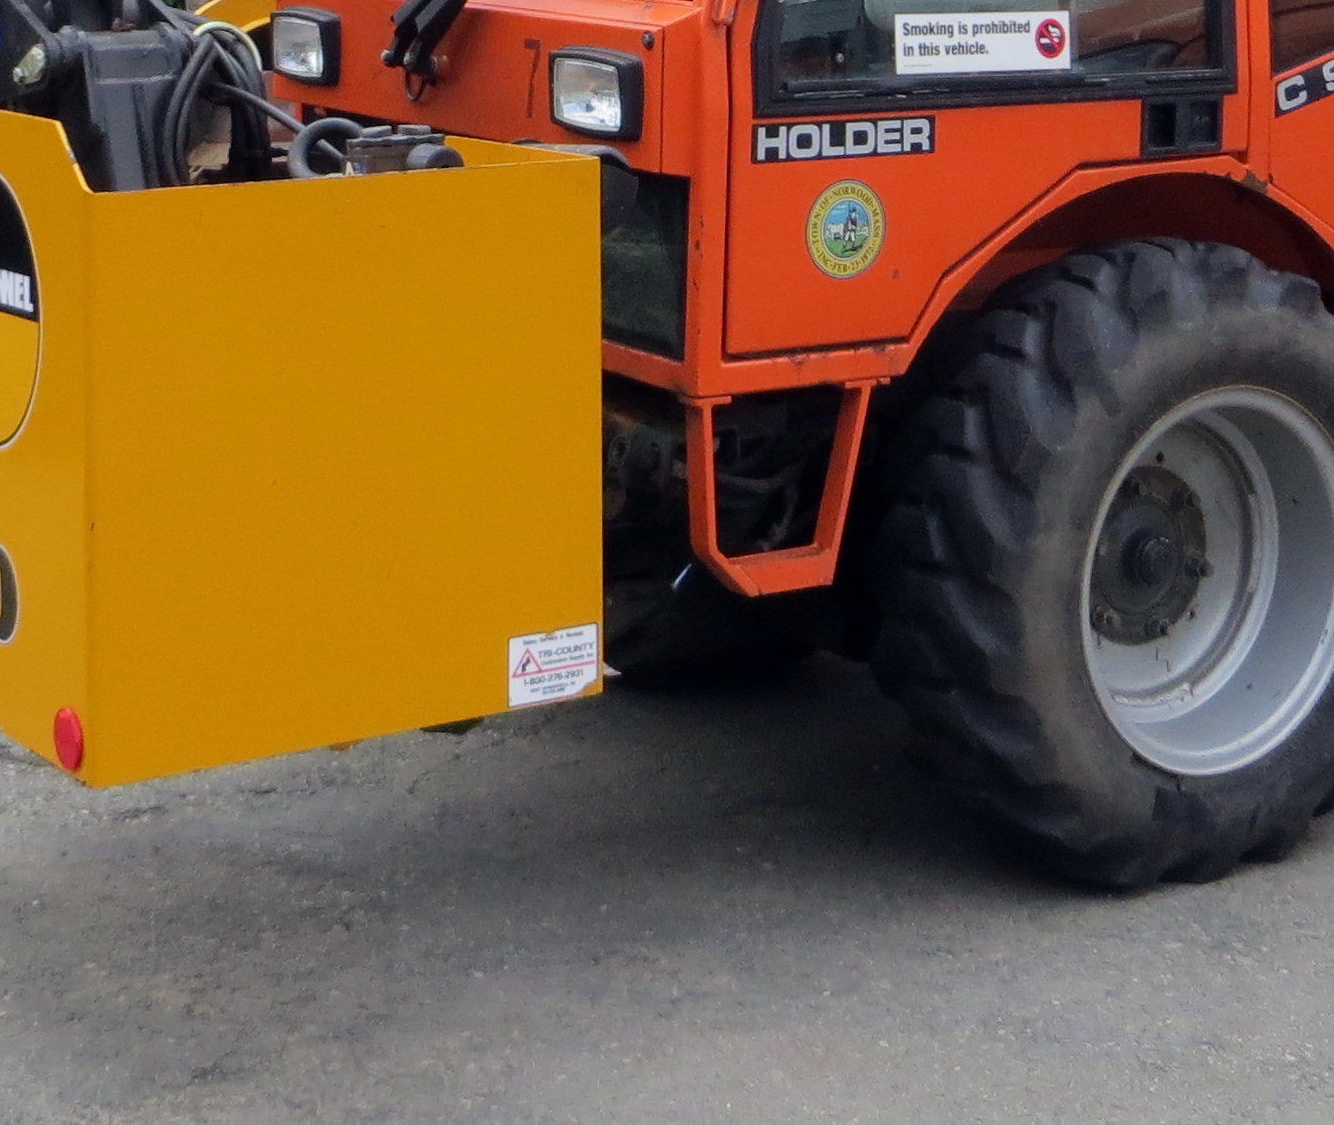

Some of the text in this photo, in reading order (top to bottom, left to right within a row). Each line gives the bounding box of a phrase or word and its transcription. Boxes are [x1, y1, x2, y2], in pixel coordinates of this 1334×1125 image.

[903, 20, 1030, 39] Smoking is prohibited
[903, 41, 989, 57] in this vehicle.
[1277, 75, 1307, 111] C
[756, 119, 930, 160] HOLDER
[811, 213, 822, 244] TOWN
[820, 197, 829, 210] OF
[831, 185, 873, 207] NORWOOD
